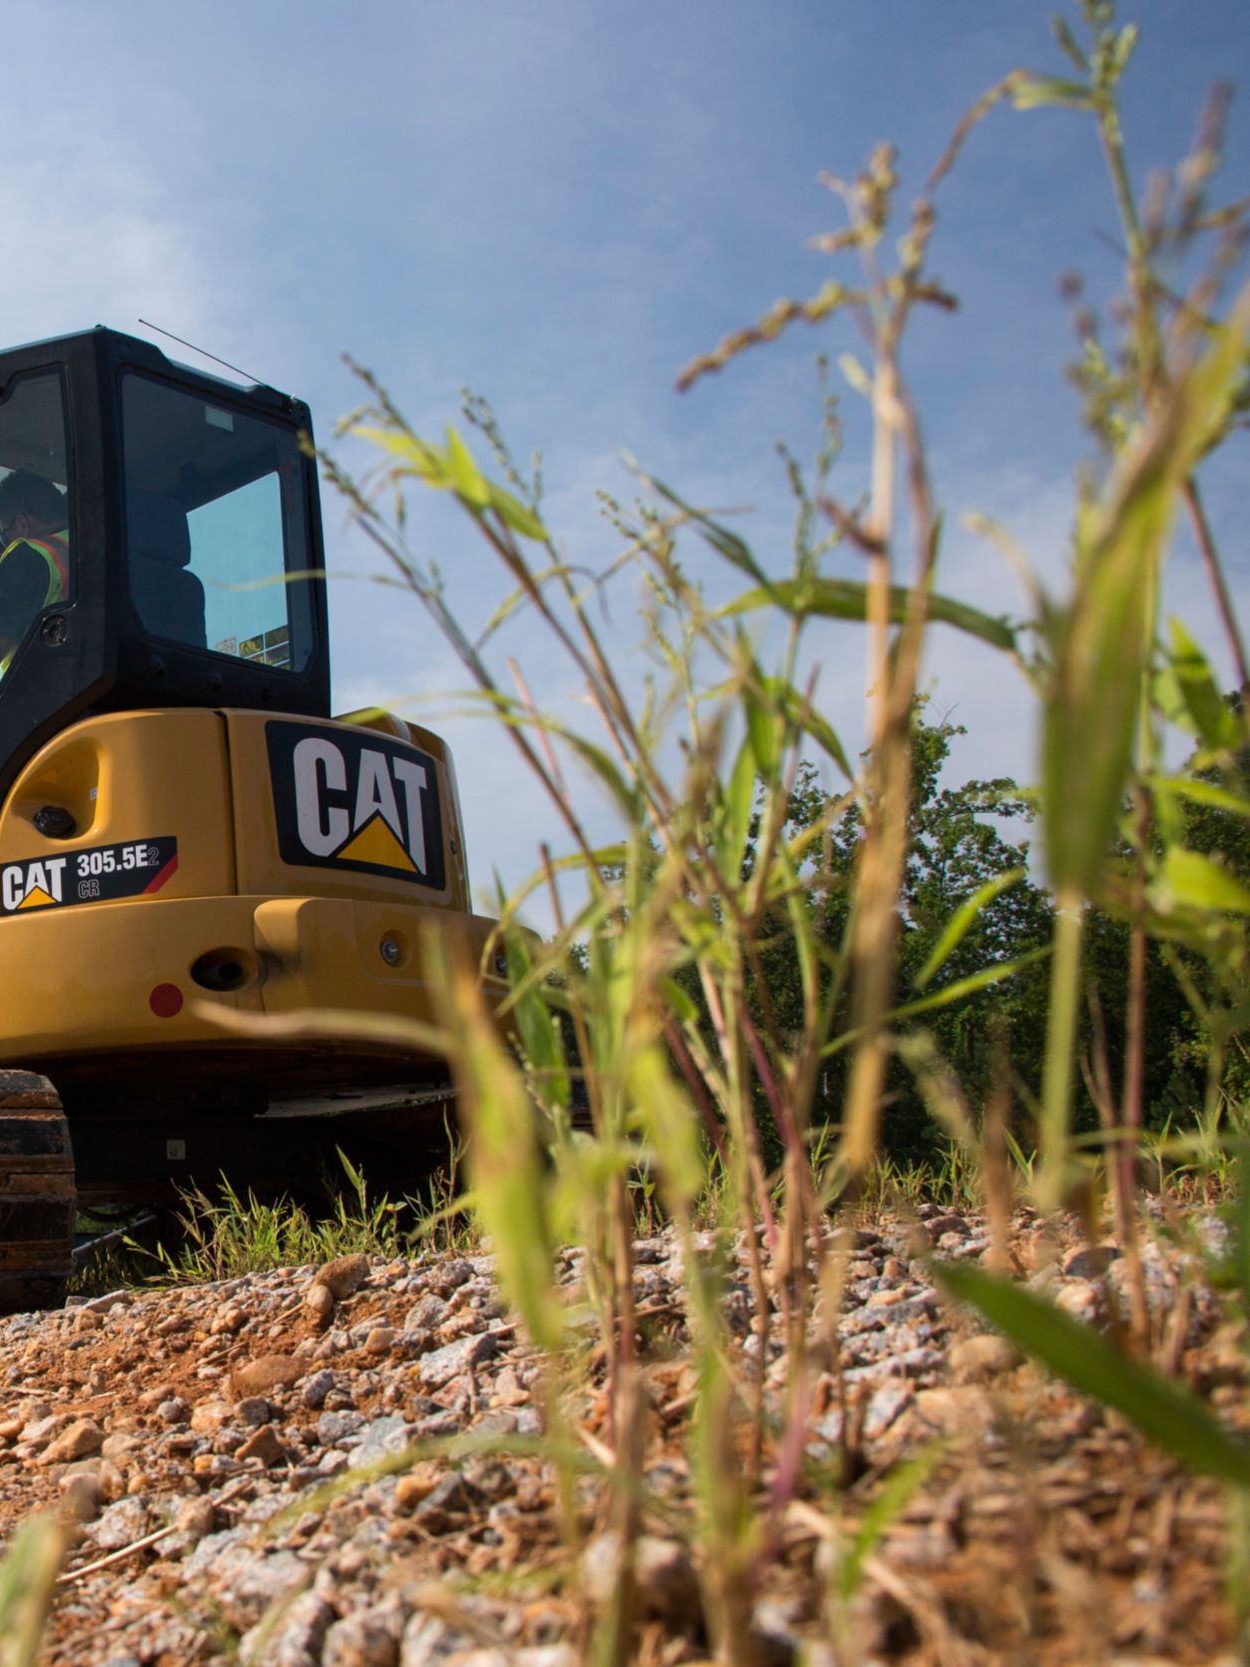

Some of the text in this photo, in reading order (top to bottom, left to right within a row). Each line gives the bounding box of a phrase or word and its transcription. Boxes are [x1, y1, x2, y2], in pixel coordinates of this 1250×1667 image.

[293, 737, 427, 876] CAT
[2, 858, 66, 910] CAT
[77, 879, 100, 898] CR
